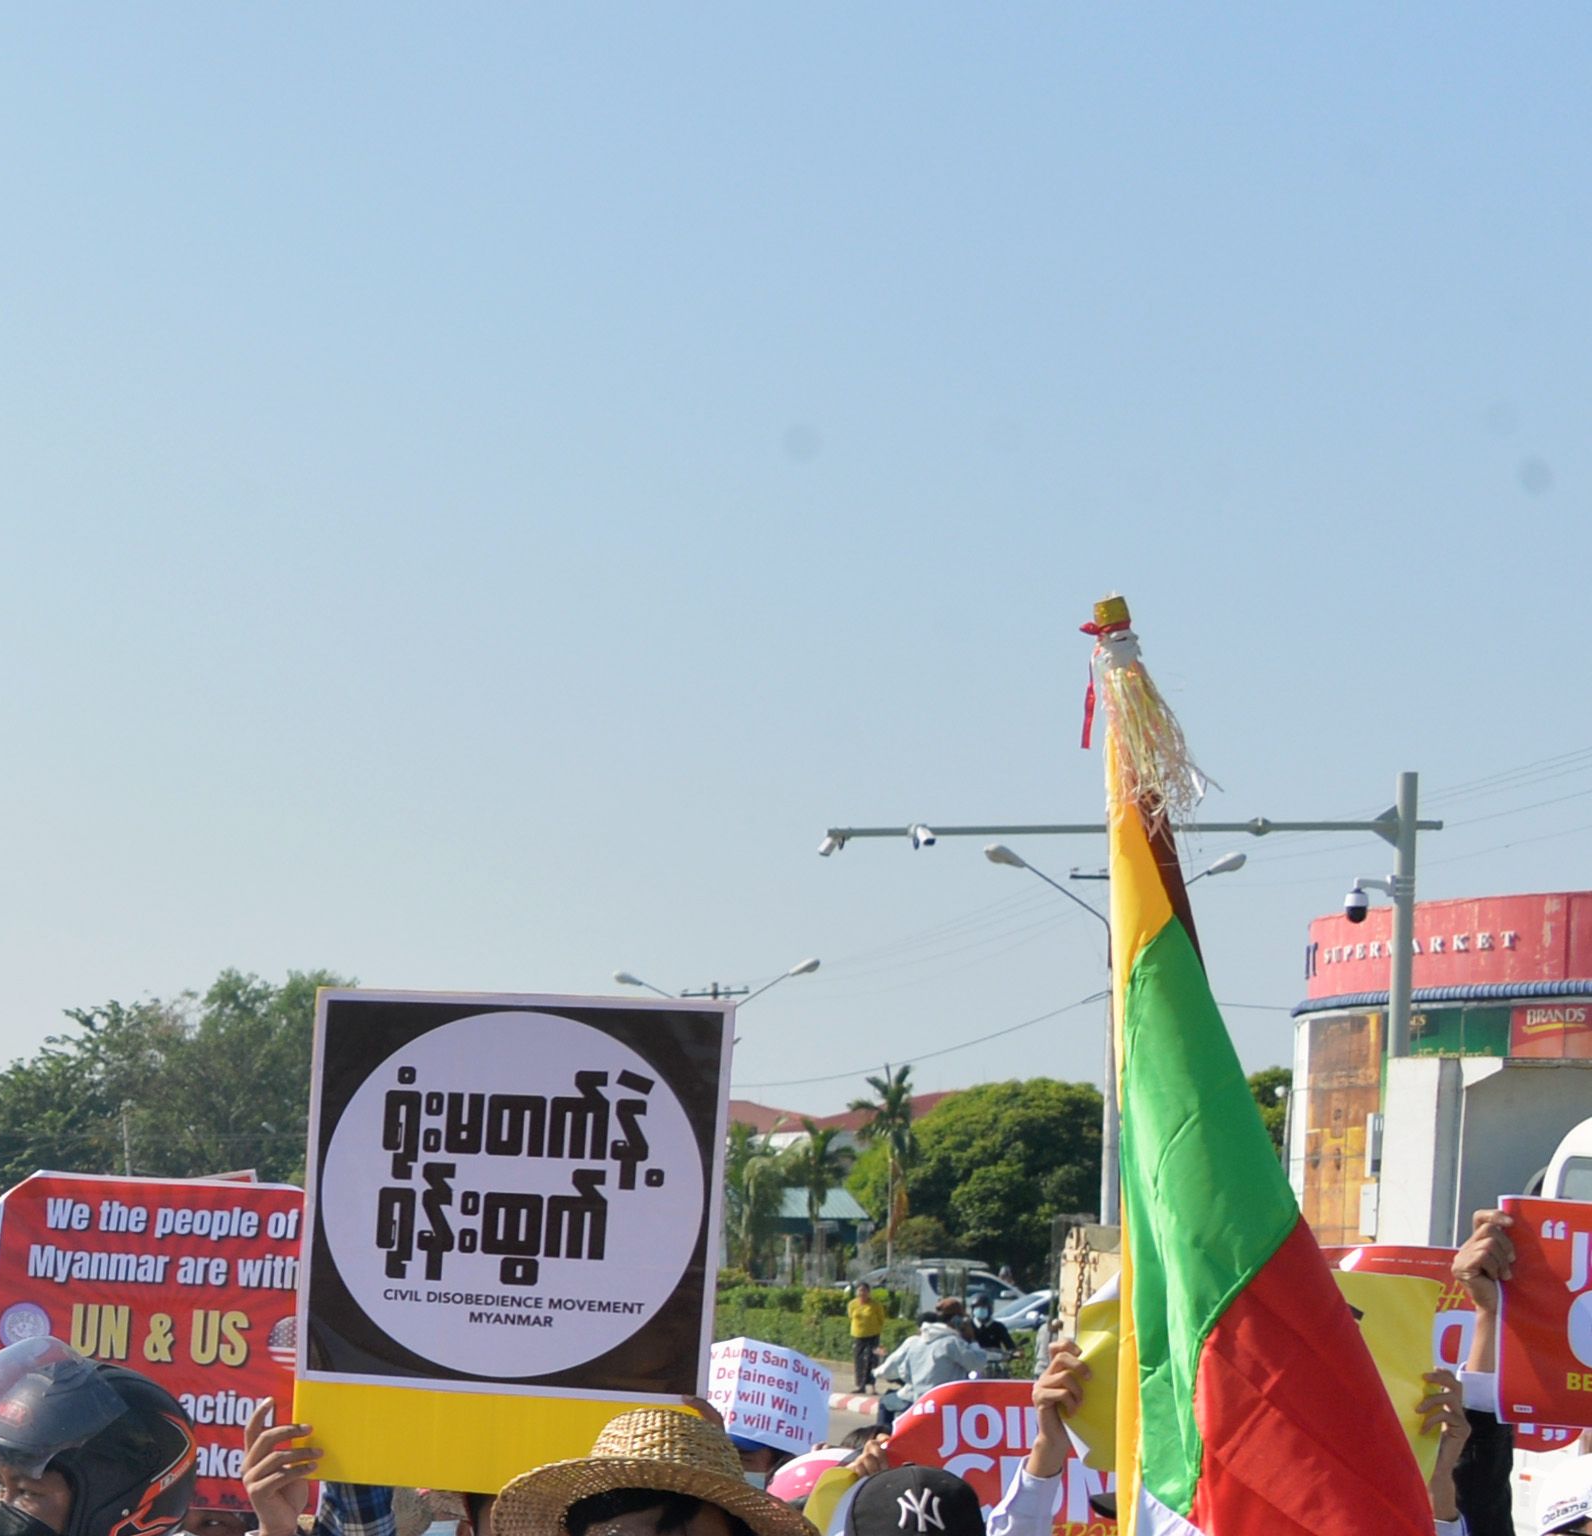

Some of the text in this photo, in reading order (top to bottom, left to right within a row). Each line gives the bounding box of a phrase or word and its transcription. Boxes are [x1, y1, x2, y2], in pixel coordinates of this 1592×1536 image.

[1324, 930, 1520, 964] SUPERARKET
[1526, 1007, 1586, 1026] BRANDS
[382, 1066, 665, 1190] ရုံးမတက်နဲ့
[47, 1197, 300, 1241] We the people of
[376, 1161, 608, 1287] ရုန်းထွက်
[28, 1244, 300, 1290] Myanmar are with
[383, 1288, 645, 1315] CIVIL DISOBEDIENCE MOVEMENT
[468, 1311, 554, 1329] MYANMAR
[70, 1303, 250, 1367] UN & US
[722, 1346, 831, 1392] Aung San Su Kyi
[737, 1390, 766, 1407] will
[771, 1395, 798, 1417] Win
[743, 1413, 771, 1432] will
[776, 1419, 805, 1441] Fall
